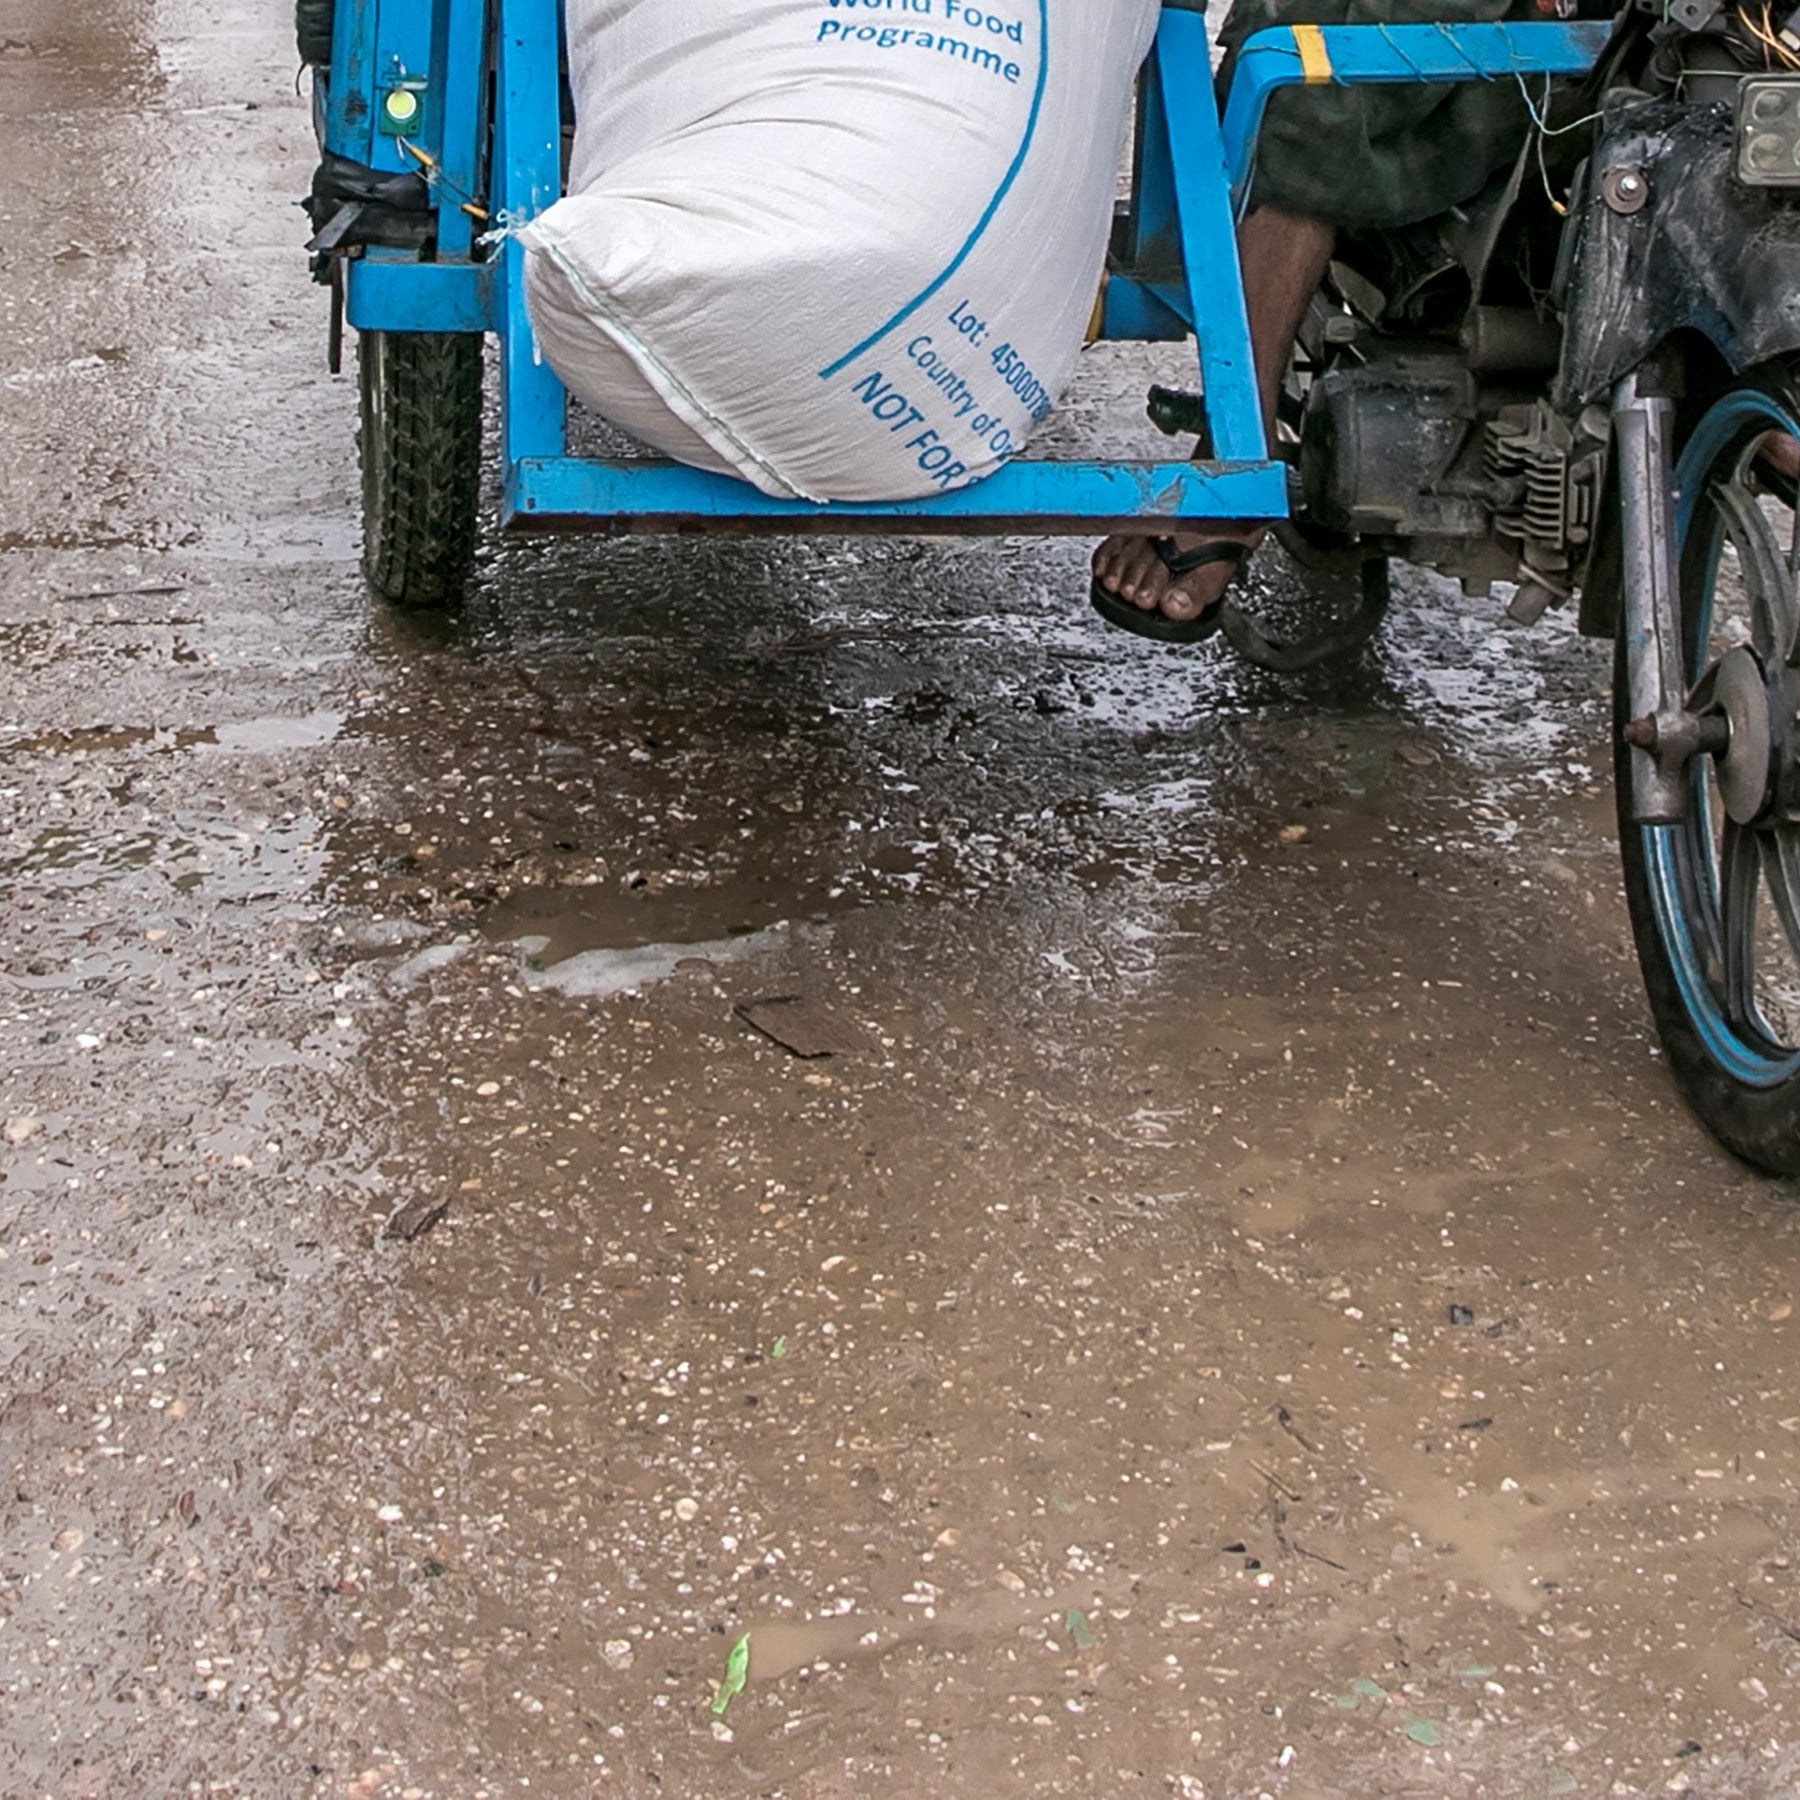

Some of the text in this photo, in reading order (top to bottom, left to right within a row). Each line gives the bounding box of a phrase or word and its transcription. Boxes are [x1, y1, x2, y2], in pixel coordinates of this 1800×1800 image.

[816, 19, 1021, 84] Programme
[947, 299, 990, 348] Lot:
[906, 335, 979, 418] Country
[970, 413, 1002, 438] of
[850, 370, 967, 489] NOT FOR
